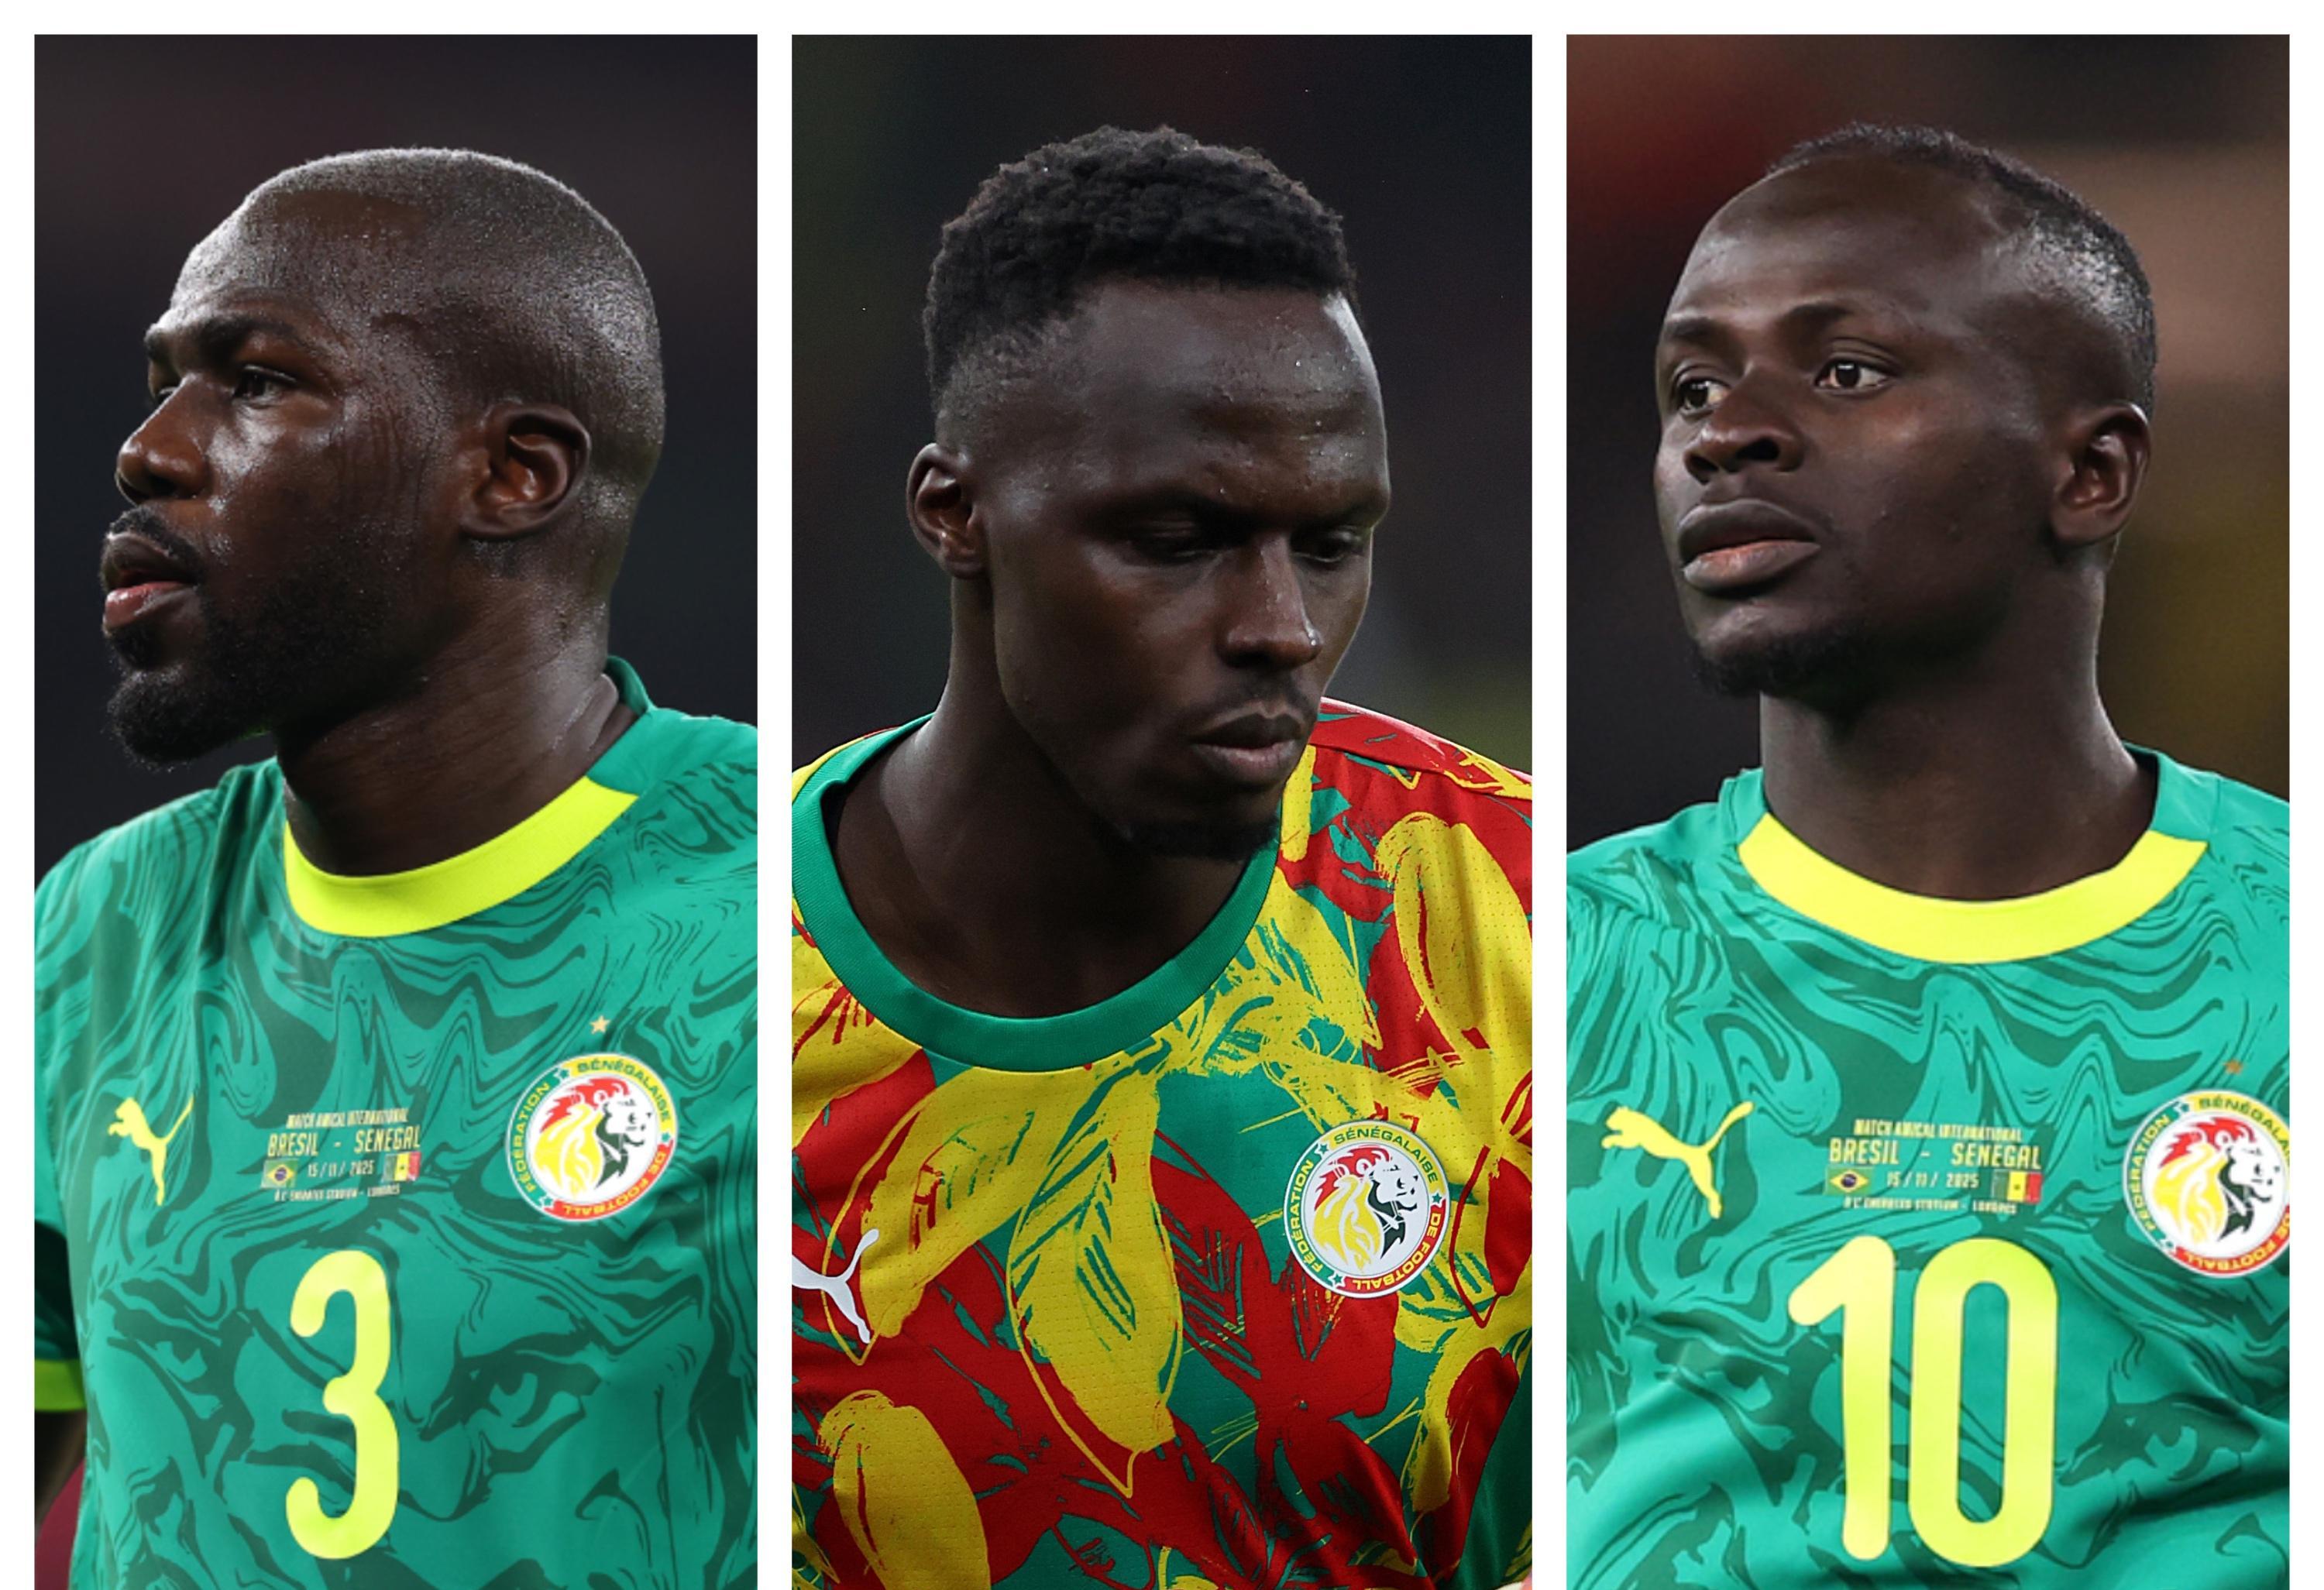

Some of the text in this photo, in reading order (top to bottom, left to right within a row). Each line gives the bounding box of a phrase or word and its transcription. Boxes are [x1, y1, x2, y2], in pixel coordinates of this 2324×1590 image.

[267, 1132, 319, 1157] BRESIL
[354, 1125, 421, 1153] SENEGAL
[1854, 1119, 1893, 1136] MATCH
[1938, 1124, 2022, 1142] INTERNATIONAL
[1829, 1138, 1899, 1164] BRESIL
[1951, 1142, 2042, 1169] SENEGAL
[562, 1178, 649, 1215] FOOTBALL
[1291, 1126, 1442, 1290] FÉDÉRATION SÉNÉGALAISE DE FOOTBALL
[2185, 1240, 2277, 1271] FOOTBALL
[285, 1249, 399, 1560] 3
[1788, 1235, 2059, 1568] 10
